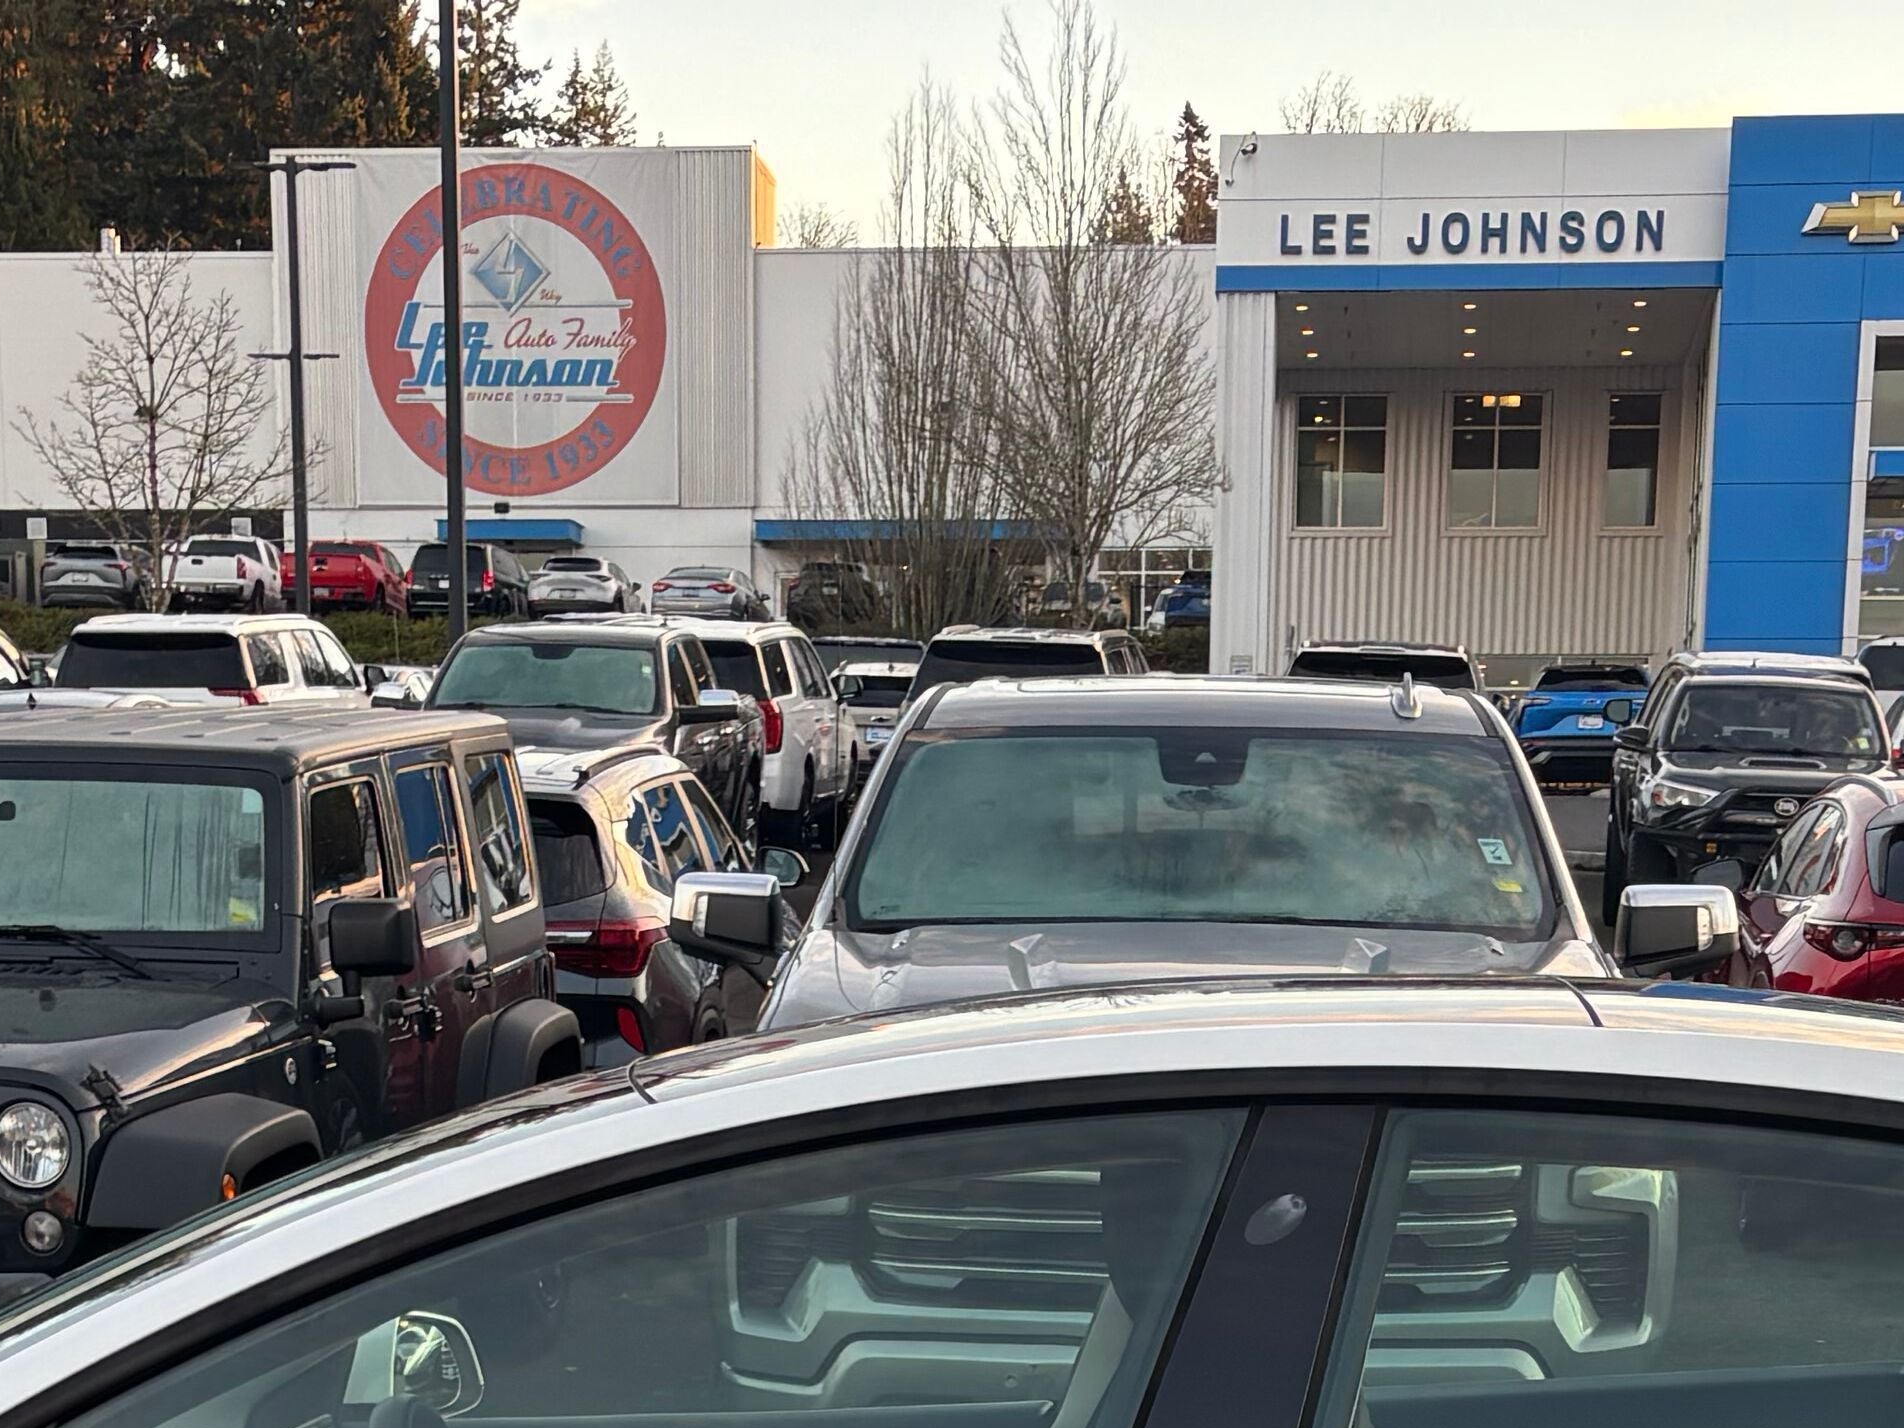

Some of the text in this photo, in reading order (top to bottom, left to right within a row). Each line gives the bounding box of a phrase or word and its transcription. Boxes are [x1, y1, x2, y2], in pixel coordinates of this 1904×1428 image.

[1280, 209, 1666, 256] LEE JOHNSON
[395, 301, 638, 361] Lee Auto Family
[400, 338, 620, 388] Johnson
[465, 392, 564, 402] SINCE 1933
[542, 417, 615, 480] 1933
